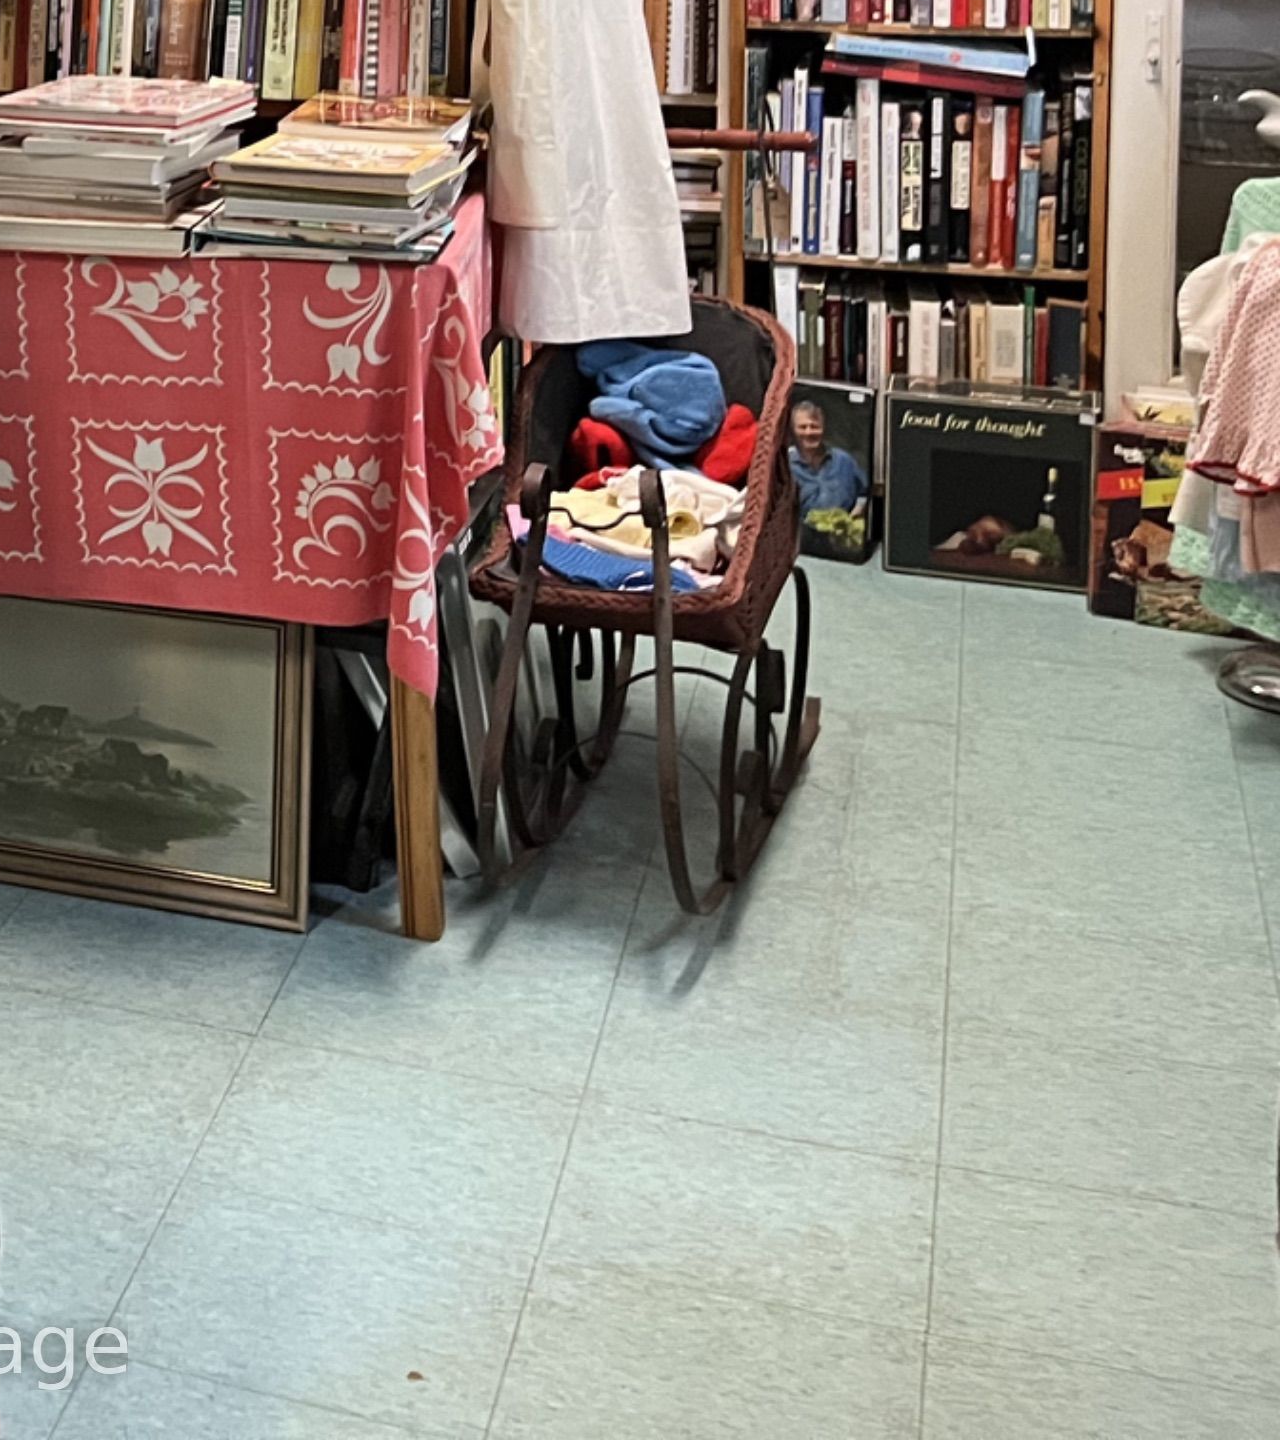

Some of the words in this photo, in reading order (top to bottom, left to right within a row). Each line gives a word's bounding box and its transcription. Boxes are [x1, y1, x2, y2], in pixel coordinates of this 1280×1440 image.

[900, 409, 941, 430] food
[943, 412, 971, 433] for
[974, 416, 1047, 439] thought
